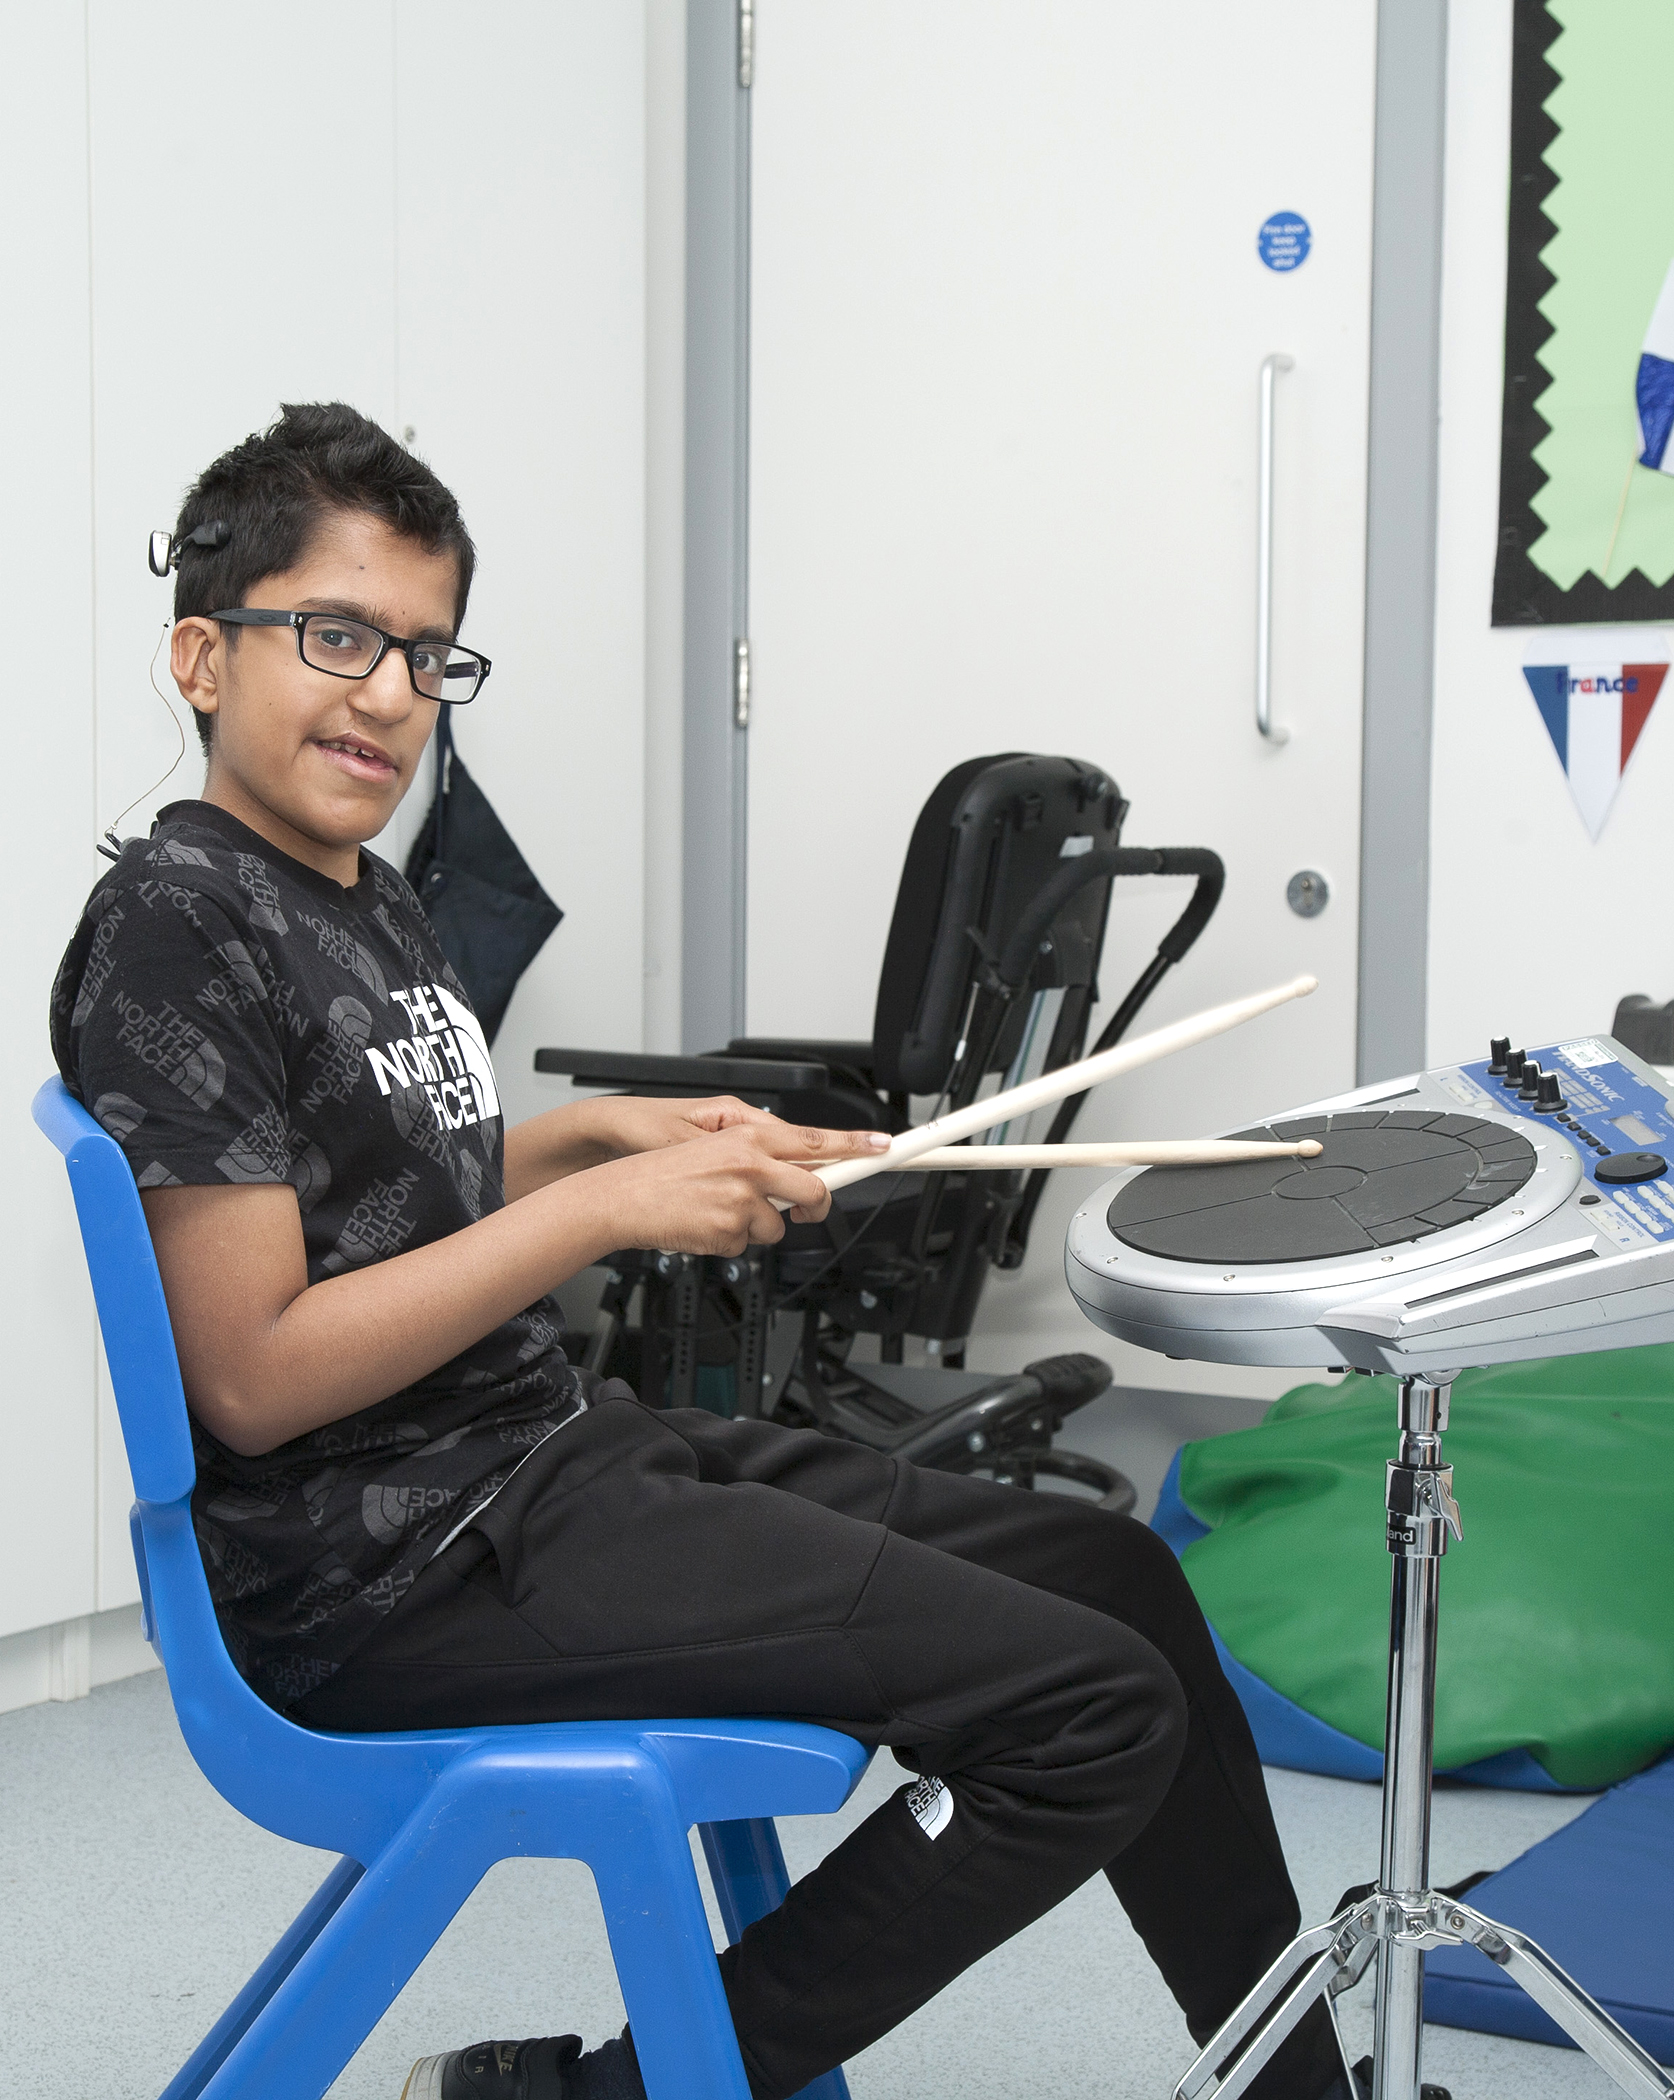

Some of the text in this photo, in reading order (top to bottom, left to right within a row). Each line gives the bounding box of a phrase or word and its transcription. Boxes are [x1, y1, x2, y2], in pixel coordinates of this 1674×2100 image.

[111, 990, 194, 1061] NORTH
[157, 1000, 206, 1049] THE
[389, 985, 449, 1035] THE
[116, 1022, 179, 1078] FACE
[305, 1019, 341, 1065] THE
[365, 1029, 466, 1096] NORTH
[331, 1041, 366, 1106] FACE
[344, 1177, 390, 1237] FACE
[363, 1166, 421, 1250] NORTH
[409, 1485, 462, 1505] ACE
